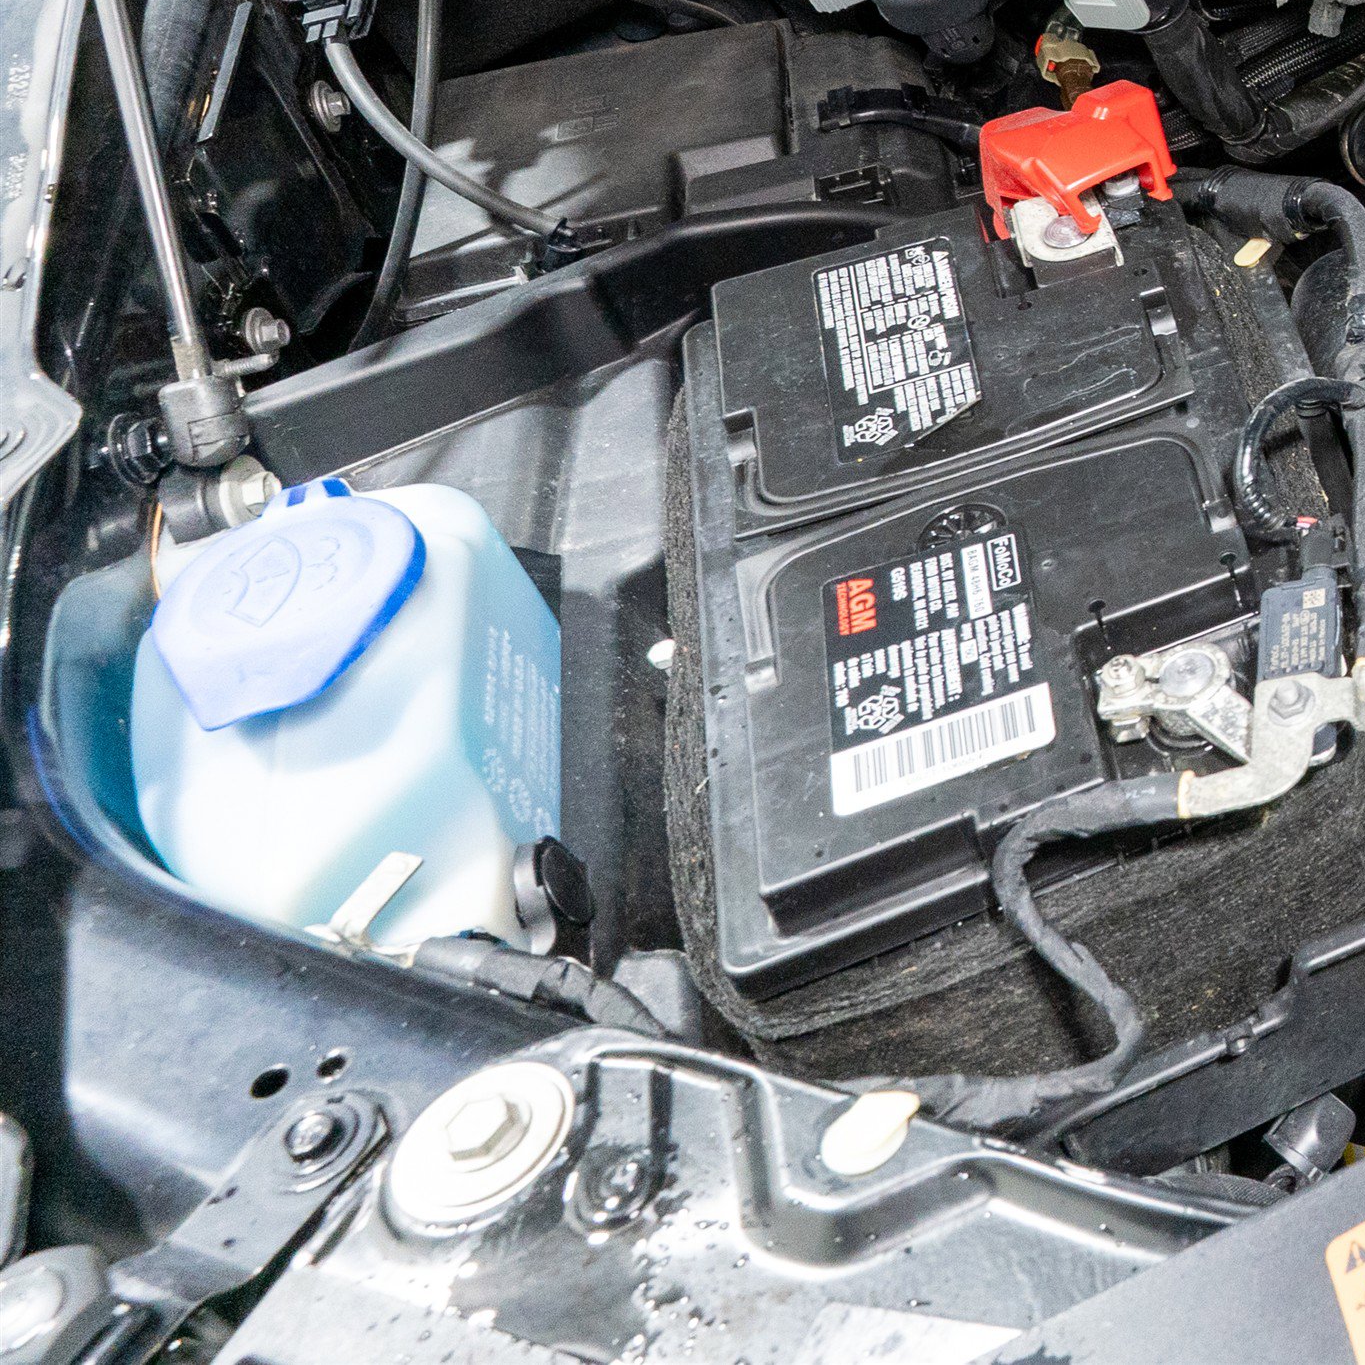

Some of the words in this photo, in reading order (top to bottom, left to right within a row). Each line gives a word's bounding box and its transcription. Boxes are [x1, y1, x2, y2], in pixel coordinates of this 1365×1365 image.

[992, 537, 1014, 586] FoMoCo
[836, 582, 850, 636] TECHNOLOGY
[848, 578, 877, 634] AGM
